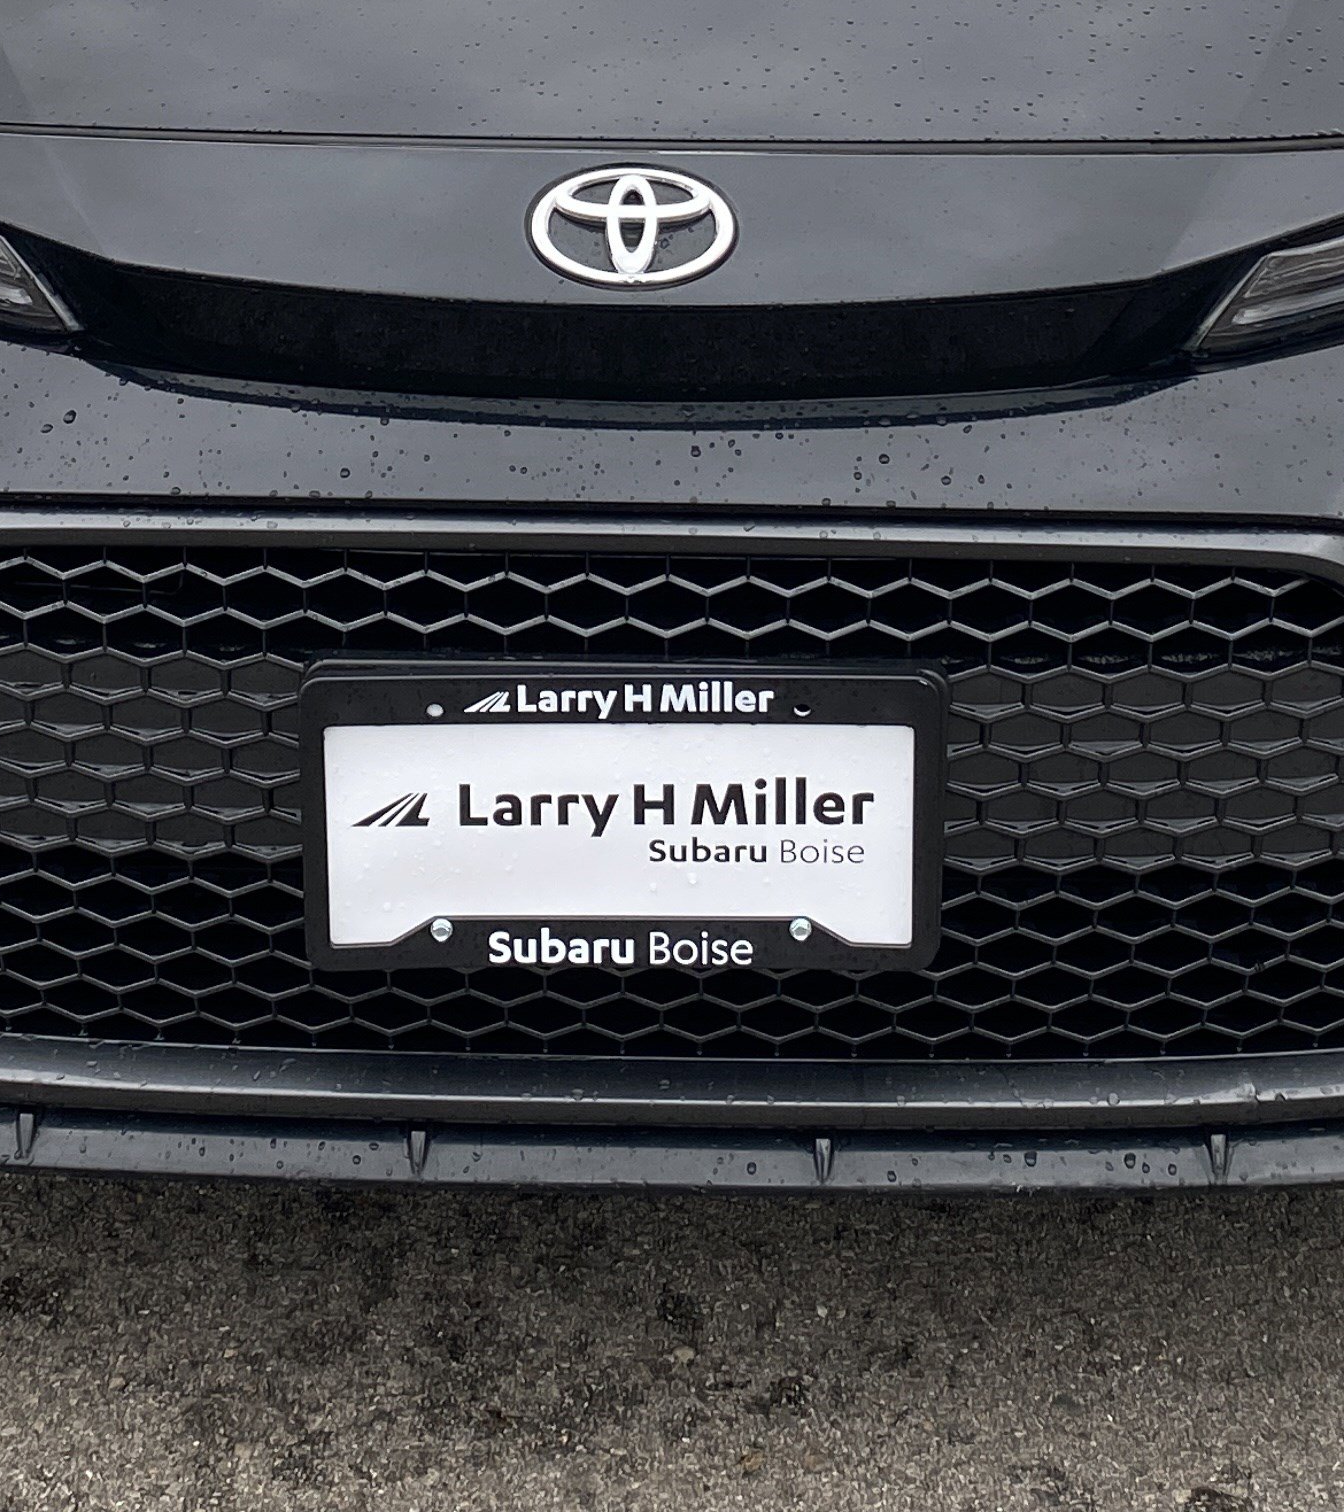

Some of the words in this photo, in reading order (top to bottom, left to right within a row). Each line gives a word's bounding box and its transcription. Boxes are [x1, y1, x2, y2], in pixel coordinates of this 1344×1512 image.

[517, 684, 618, 720] Larry
[624, 684, 652, 713] H
[659, 681, 775, 713] Miller
[459, 783, 620, 838] Larry
[633, 783, 675, 825] H
[690, 777, 875, 825] Miller
[649, 837, 767, 863] Subaru
[780, 838, 865, 864] Boise
[488, 927, 635, 965] Subaru
[649, 930, 754, 966] Boise
